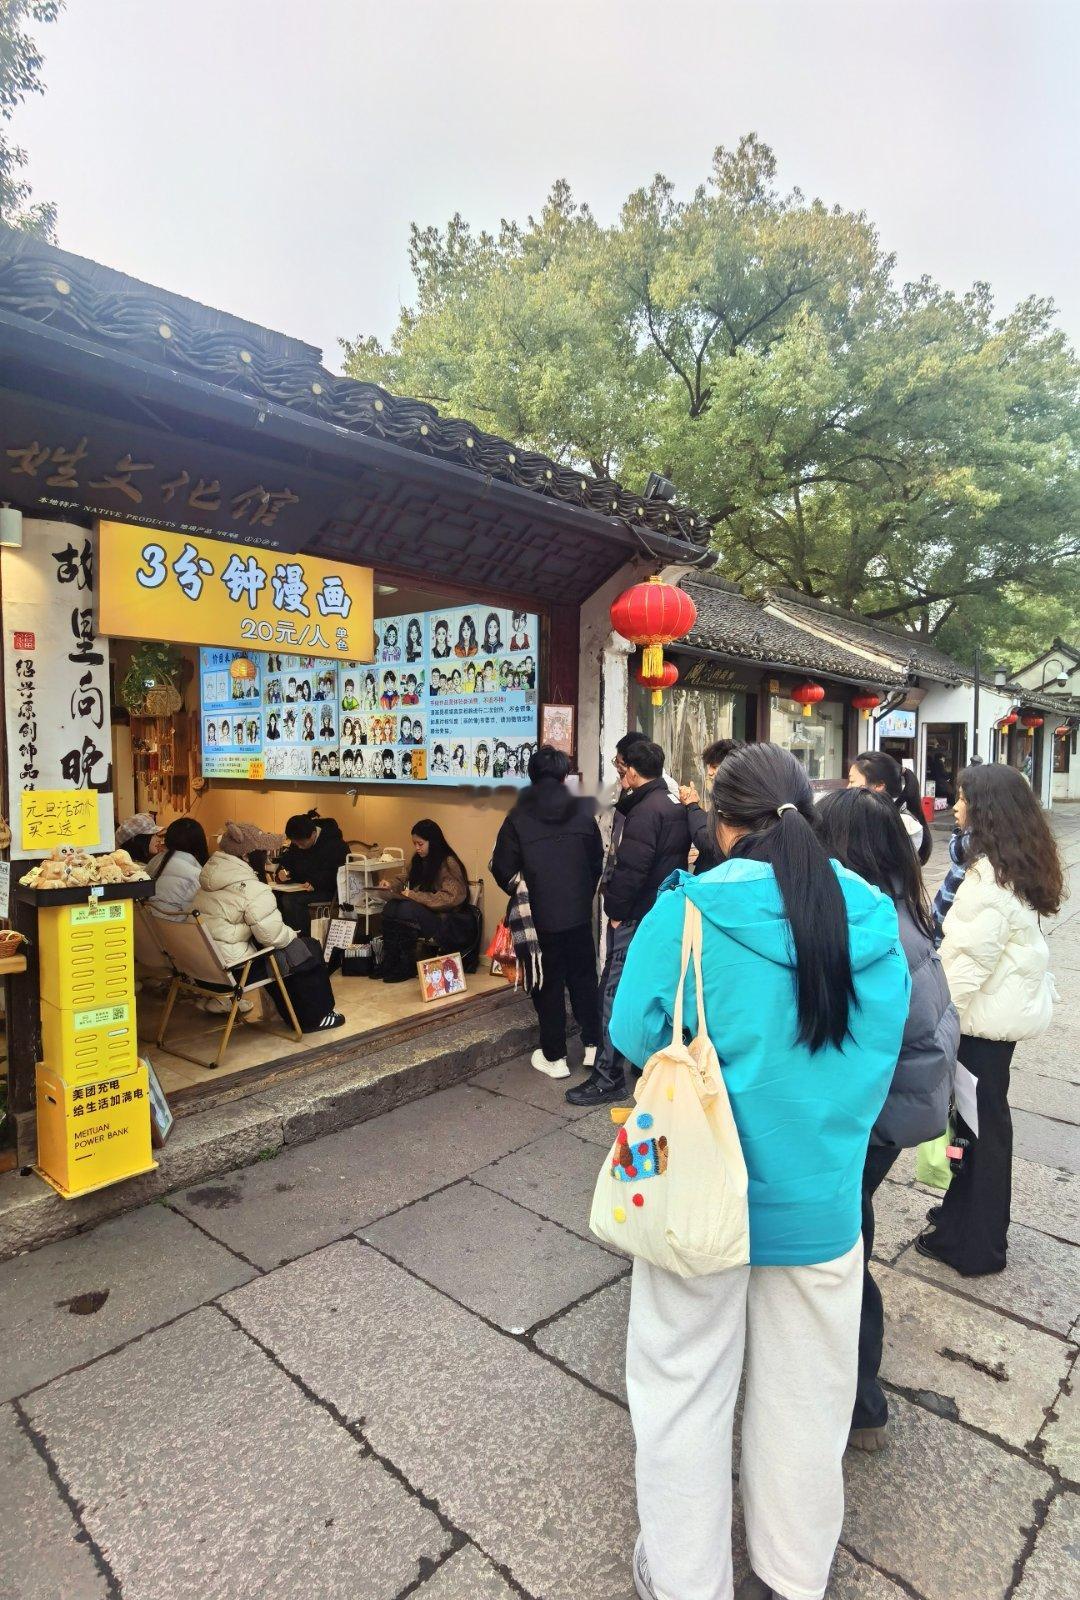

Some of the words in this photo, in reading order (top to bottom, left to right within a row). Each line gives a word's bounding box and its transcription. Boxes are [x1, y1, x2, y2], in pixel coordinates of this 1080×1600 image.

[83, 505, 122, 519] NATIVE
[125, 512, 176, 528] PRODUCTS
[136, 543, 353, 619] 3分钟漫画
[240, 618, 330, 649] 20元/人
[336, 626, 349, 651] 单色
[28, 820, 87, 838] 买二送一
[73, 1079, 120, 1101] 美团充电
[73, 1088, 144, 1117] 给生活加满电
[74, 1123, 110, 1140] MEITUAN
[74, 1134, 105, 1150] POWER
[107, 1126, 129, 1140] BANK
